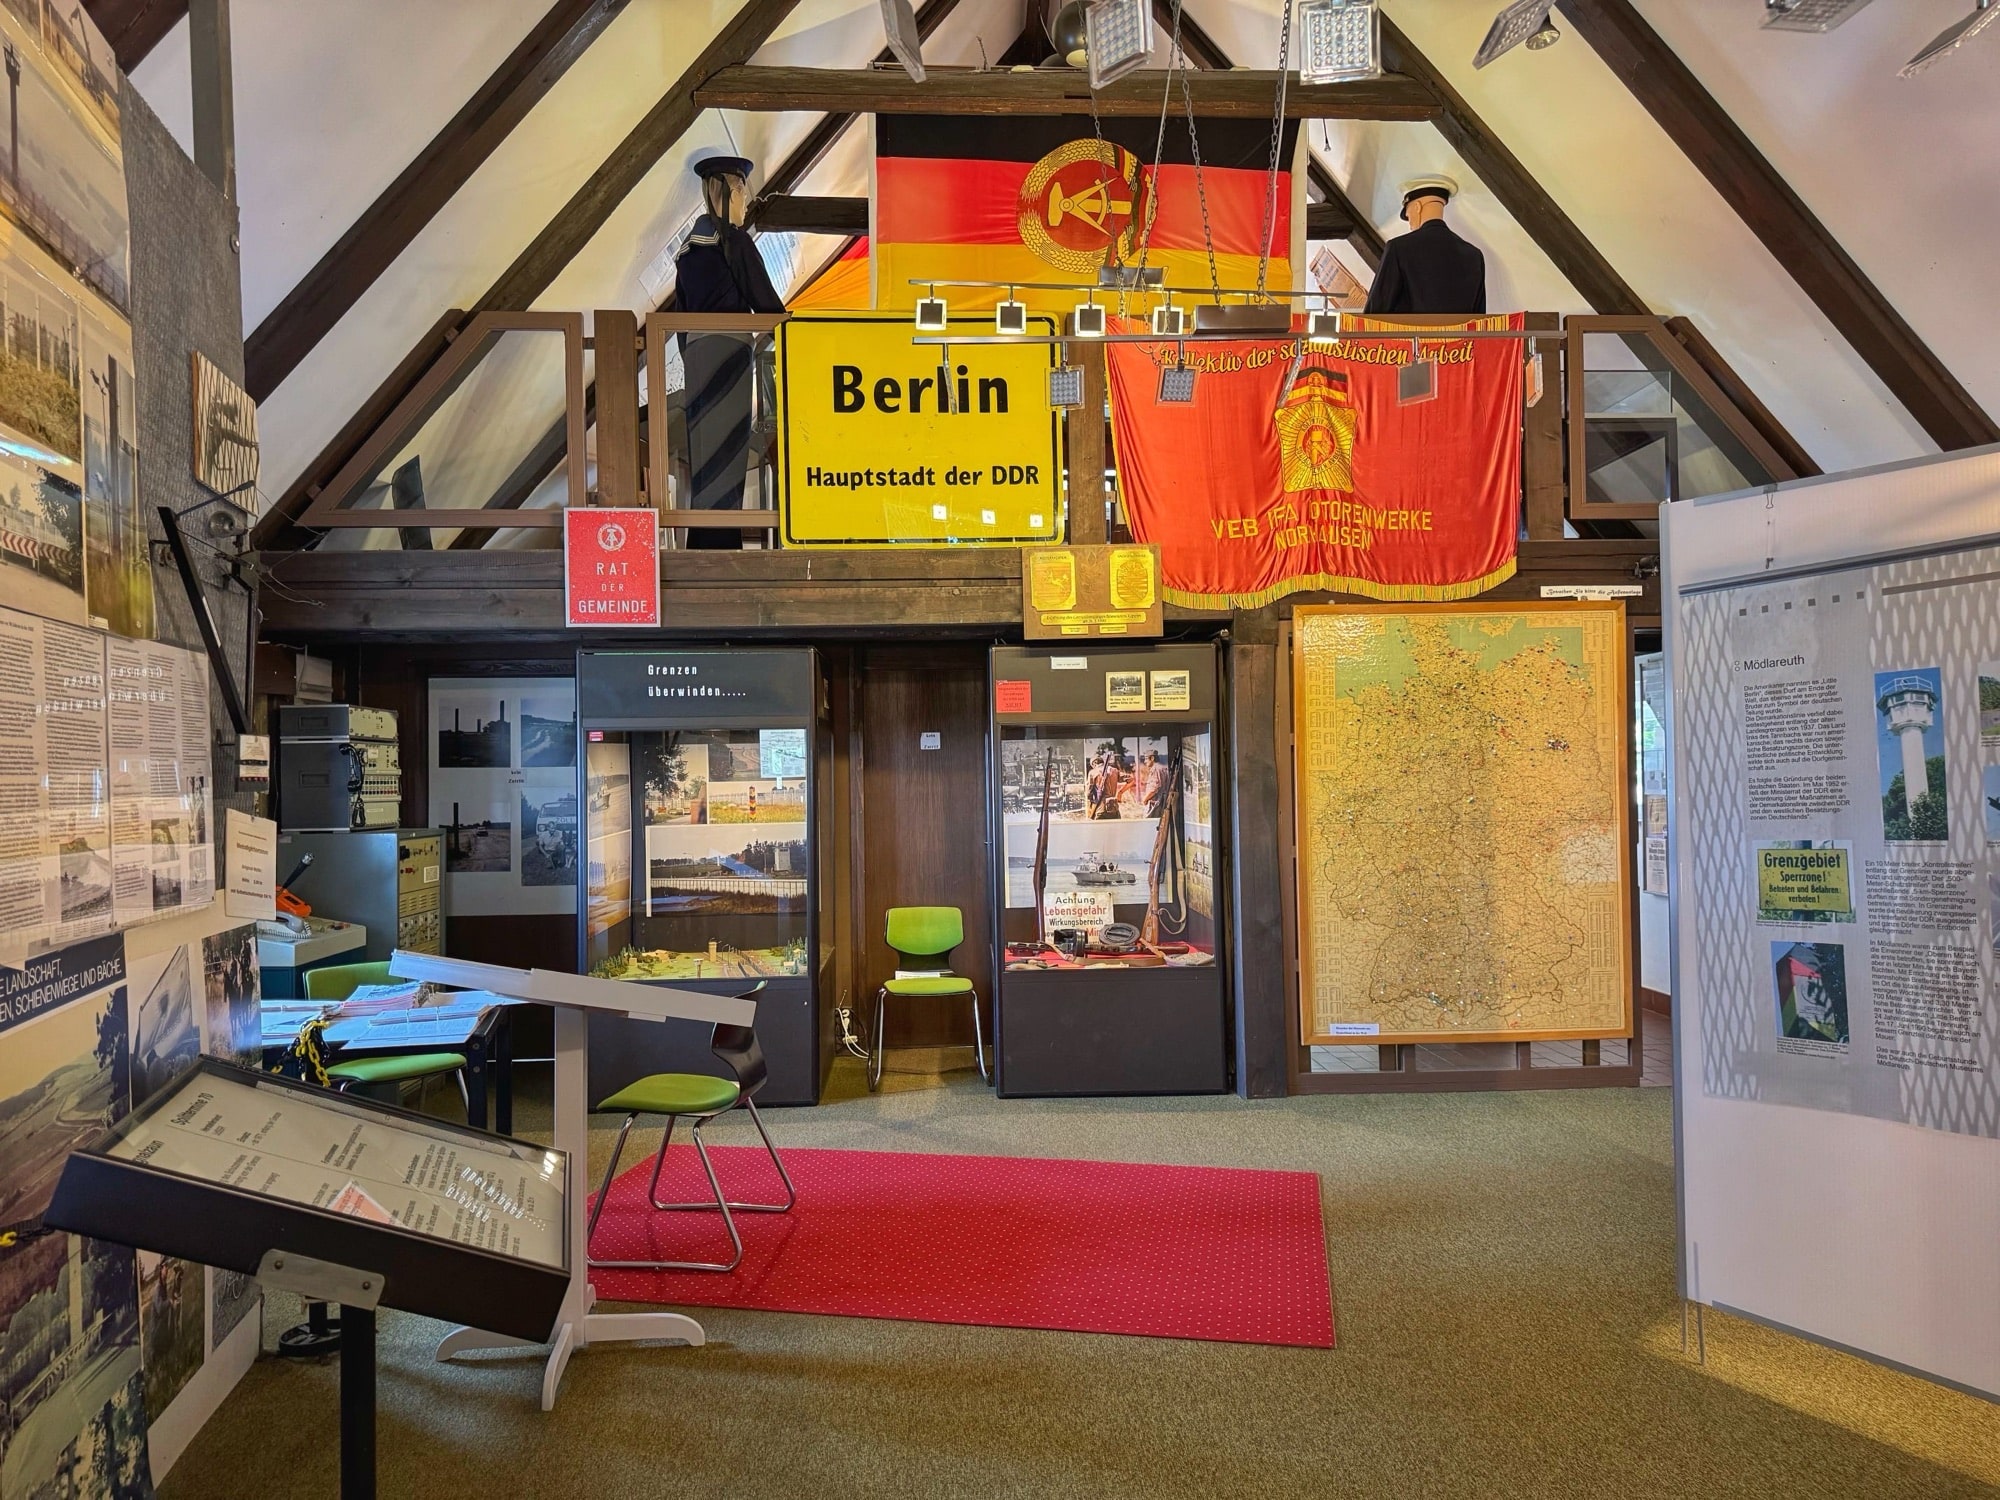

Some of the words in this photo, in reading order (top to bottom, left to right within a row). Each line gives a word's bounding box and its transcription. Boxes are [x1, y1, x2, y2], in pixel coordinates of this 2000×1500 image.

[1246, 347, 1276, 370] der
[832, 364, 1008, 414] Berlin
[806, 466, 936, 490] Hauptstadt
[945, 466, 982, 486] der
[992, 465, 1040, 485] DDR
[1210, 518, 1259, 539] VEB
[1267, 503, 1299, 530] IFA
[596, 562, 629, 575] RAT
[601, 583, 624, 592] DER
[578, 600, 648, 614] GEMEINDE
[1744, 655, 1805, 671] Mödlareuth
[648, 664, 697, 676] Grenzen
[648, 686, 746, 697] überwinden.....
[1764, 852, 1840, 870] Grenzgebiet
[1780, 871, 1826, 883] Sperrzone!
[1769, 884, 1794, 892] Betreten
[1811, 885, 1839, 893] Befahren
[1056, 896, 1095, 905] Achtung
[1788, 895, 1820, 903] verboten!
[1045, 906, 1107, 917] Lebensgefahr
[1049, 918, 1103, 927] Wirkungsbereich
[6, 958, 63, 995] LANDSCHAFT,
[16, 974, 79, 1016] SCHIENENWEGE
[80, 969, 97, 988] UND
[97, 958, 122, 982] BÄCHE
